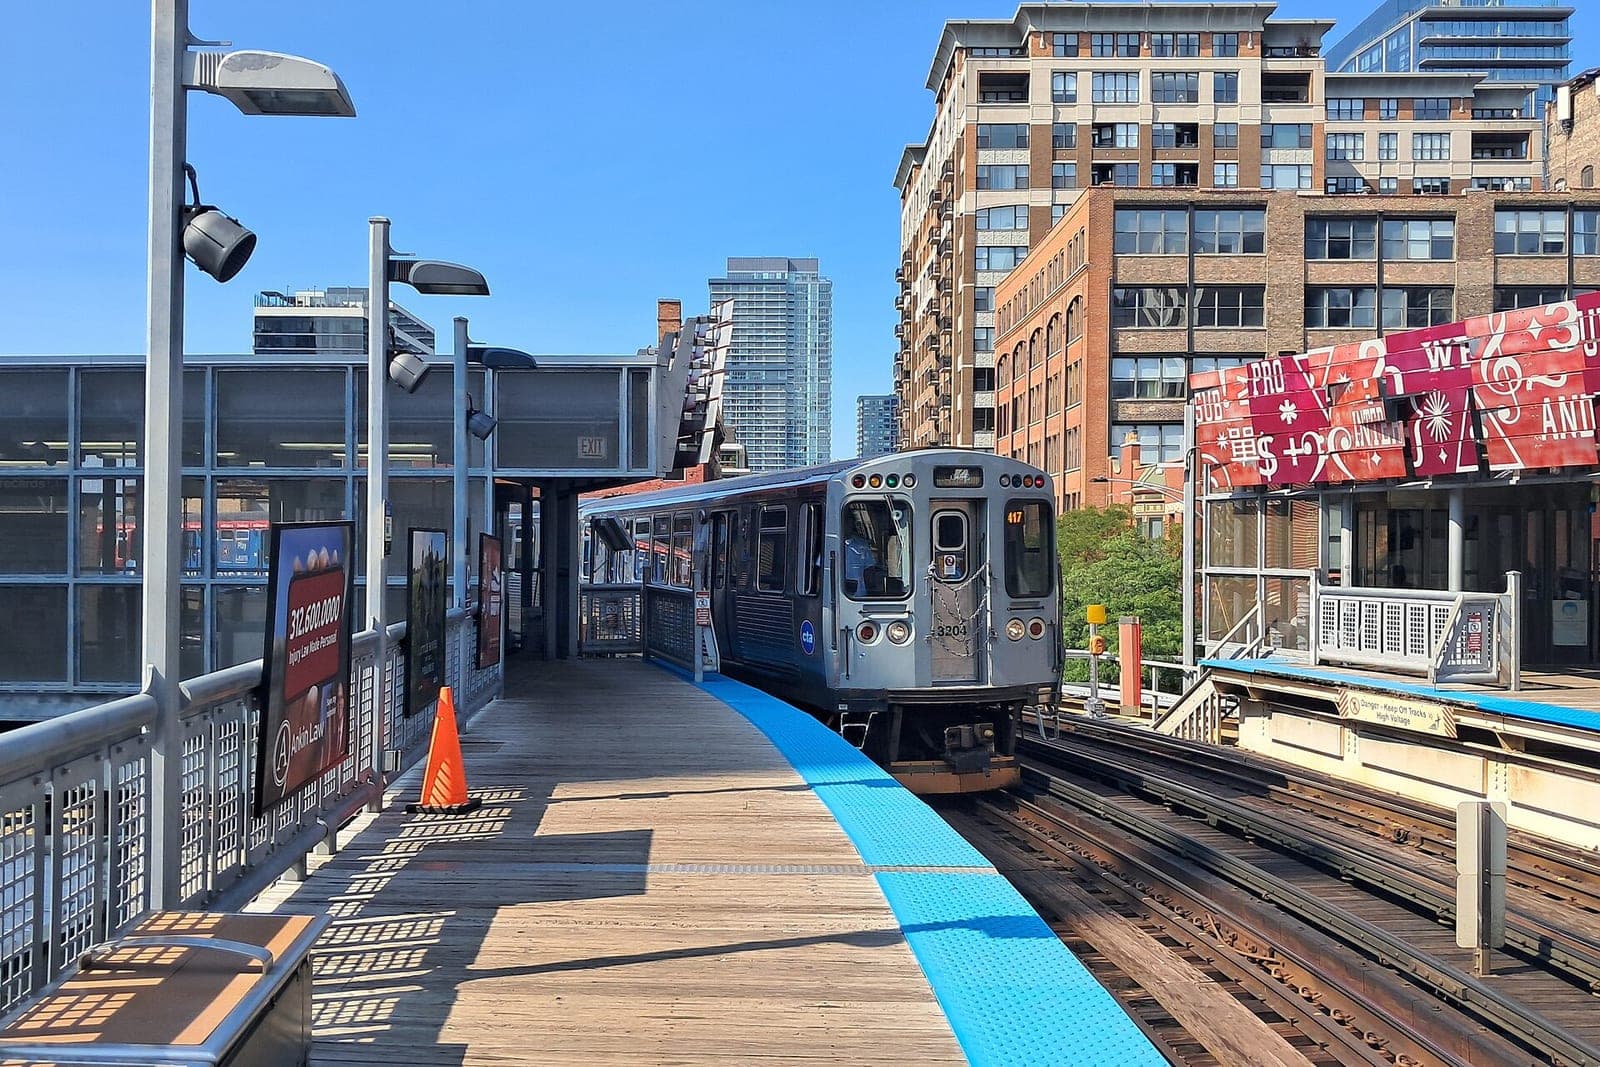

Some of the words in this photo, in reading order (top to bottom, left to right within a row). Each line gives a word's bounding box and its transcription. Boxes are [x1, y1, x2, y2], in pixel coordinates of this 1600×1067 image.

[1251, 359, 1285, 396] PRO
[1194, 388, 1223, 424] SUB
[1543, 394, 1597, 440] AND
[582, 439, 602, 454] EXIT
[1007, 511, 1022, 523] 417
[290, 595, 341, 639] 312.600.0000
[802, 631, 813, 643] cta
[937, 626, 967, 637] 3204
[289, 649, 301, 666] Injury
[301, 643, 309, 658] Law
[320, 631, 337, 649] Personal
[1361, 699, 1380, 711] Danger
[1384, 703, 1398, 715] Keep
[1399, 705, 1408, 714] Off
[1409, 707, 1427, 719] Tracks
[1376, 711, 1390, 721] High
[1390, 713, 1411, 725] Voltage
[310, 721, 325, 743] Law
